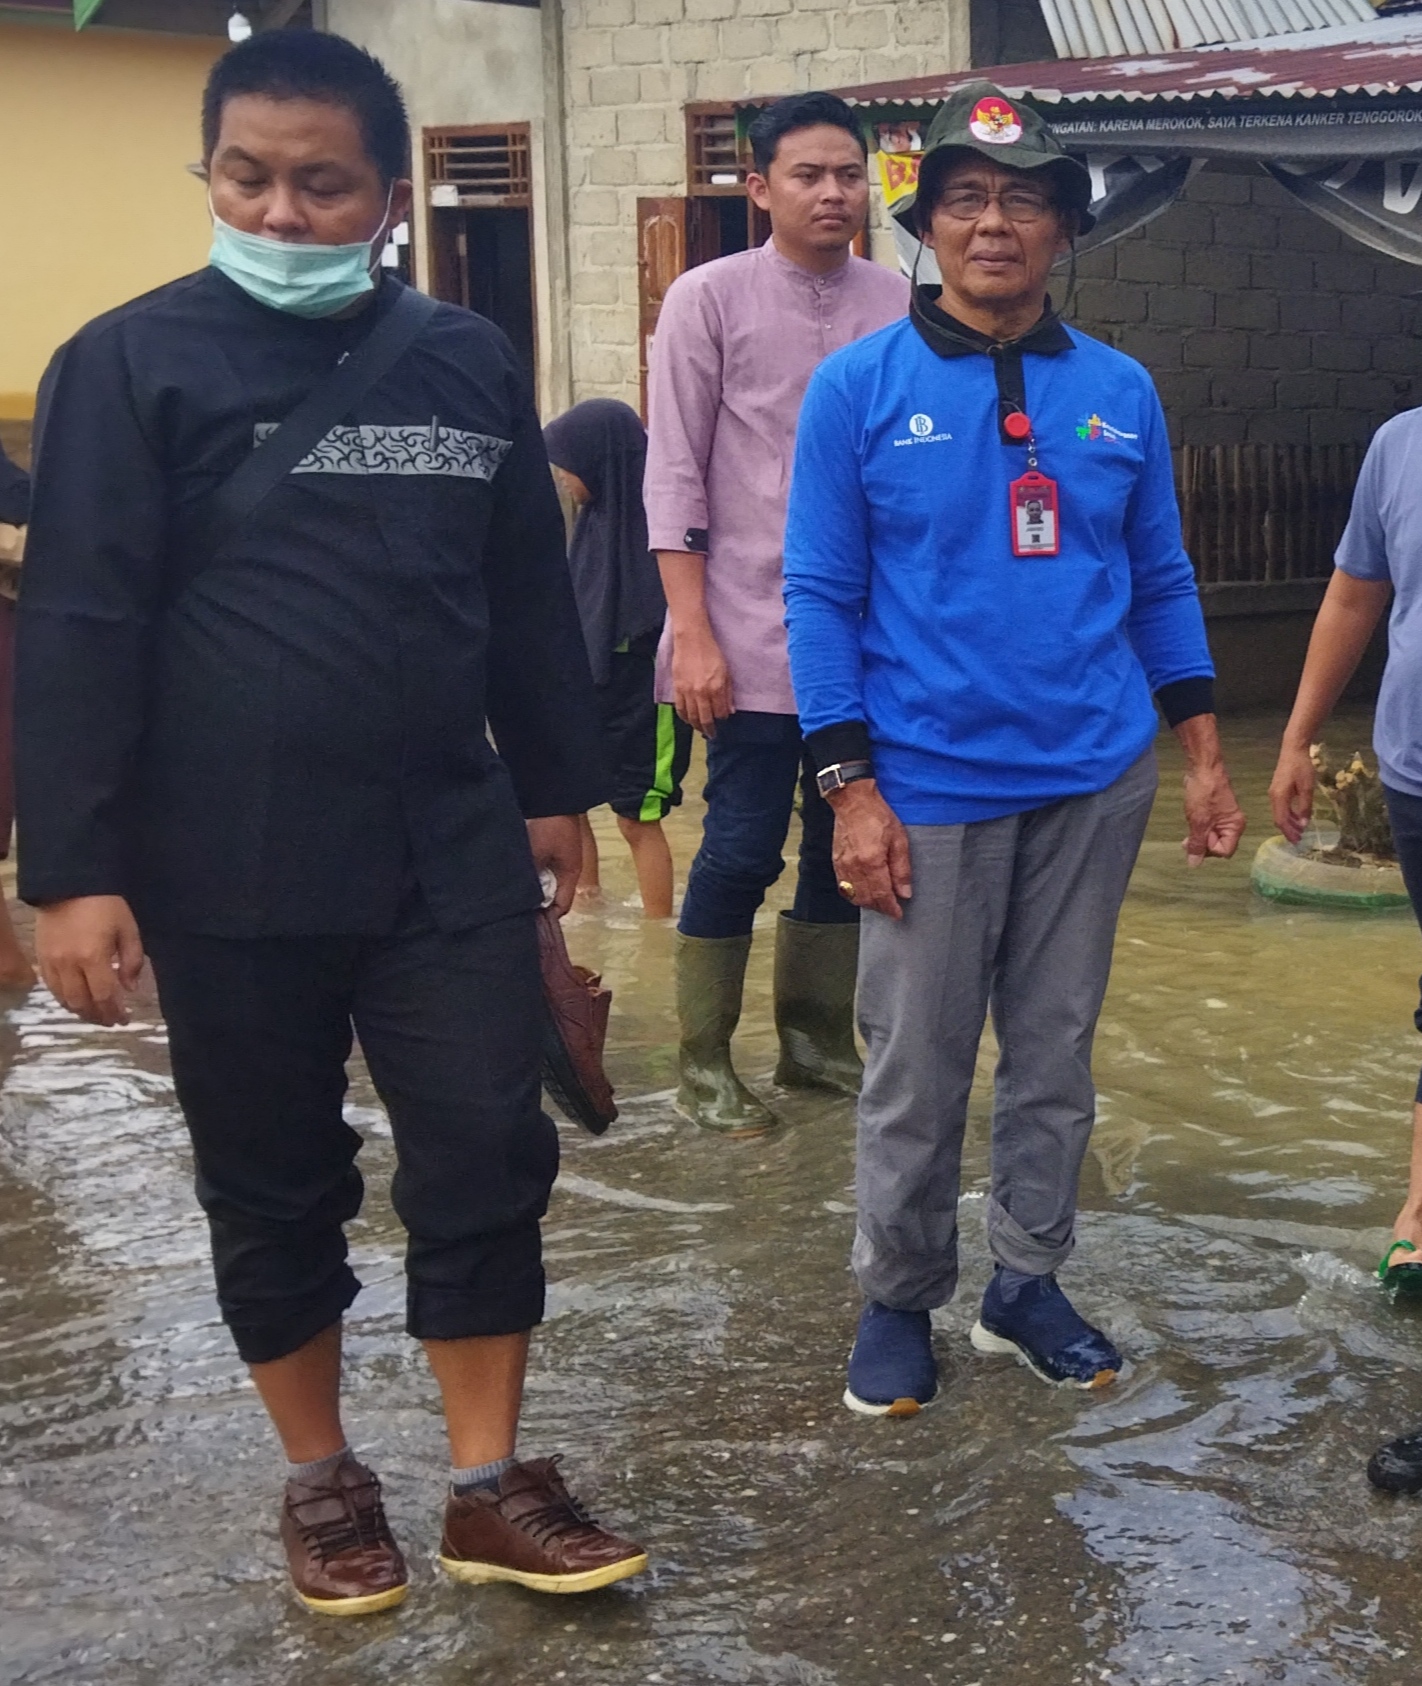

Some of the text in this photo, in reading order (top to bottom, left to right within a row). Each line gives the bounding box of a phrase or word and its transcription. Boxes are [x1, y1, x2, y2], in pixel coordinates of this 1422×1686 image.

[1099, 118, 1145, 132] KARENA
[1145, 116, 1204, 131] MEROKOK,
[1207, 115, 1237, 129] SAYA
[1238, 114, 1293, 128] TERKENA
[1294, 112, 1346, 126] KANKER
